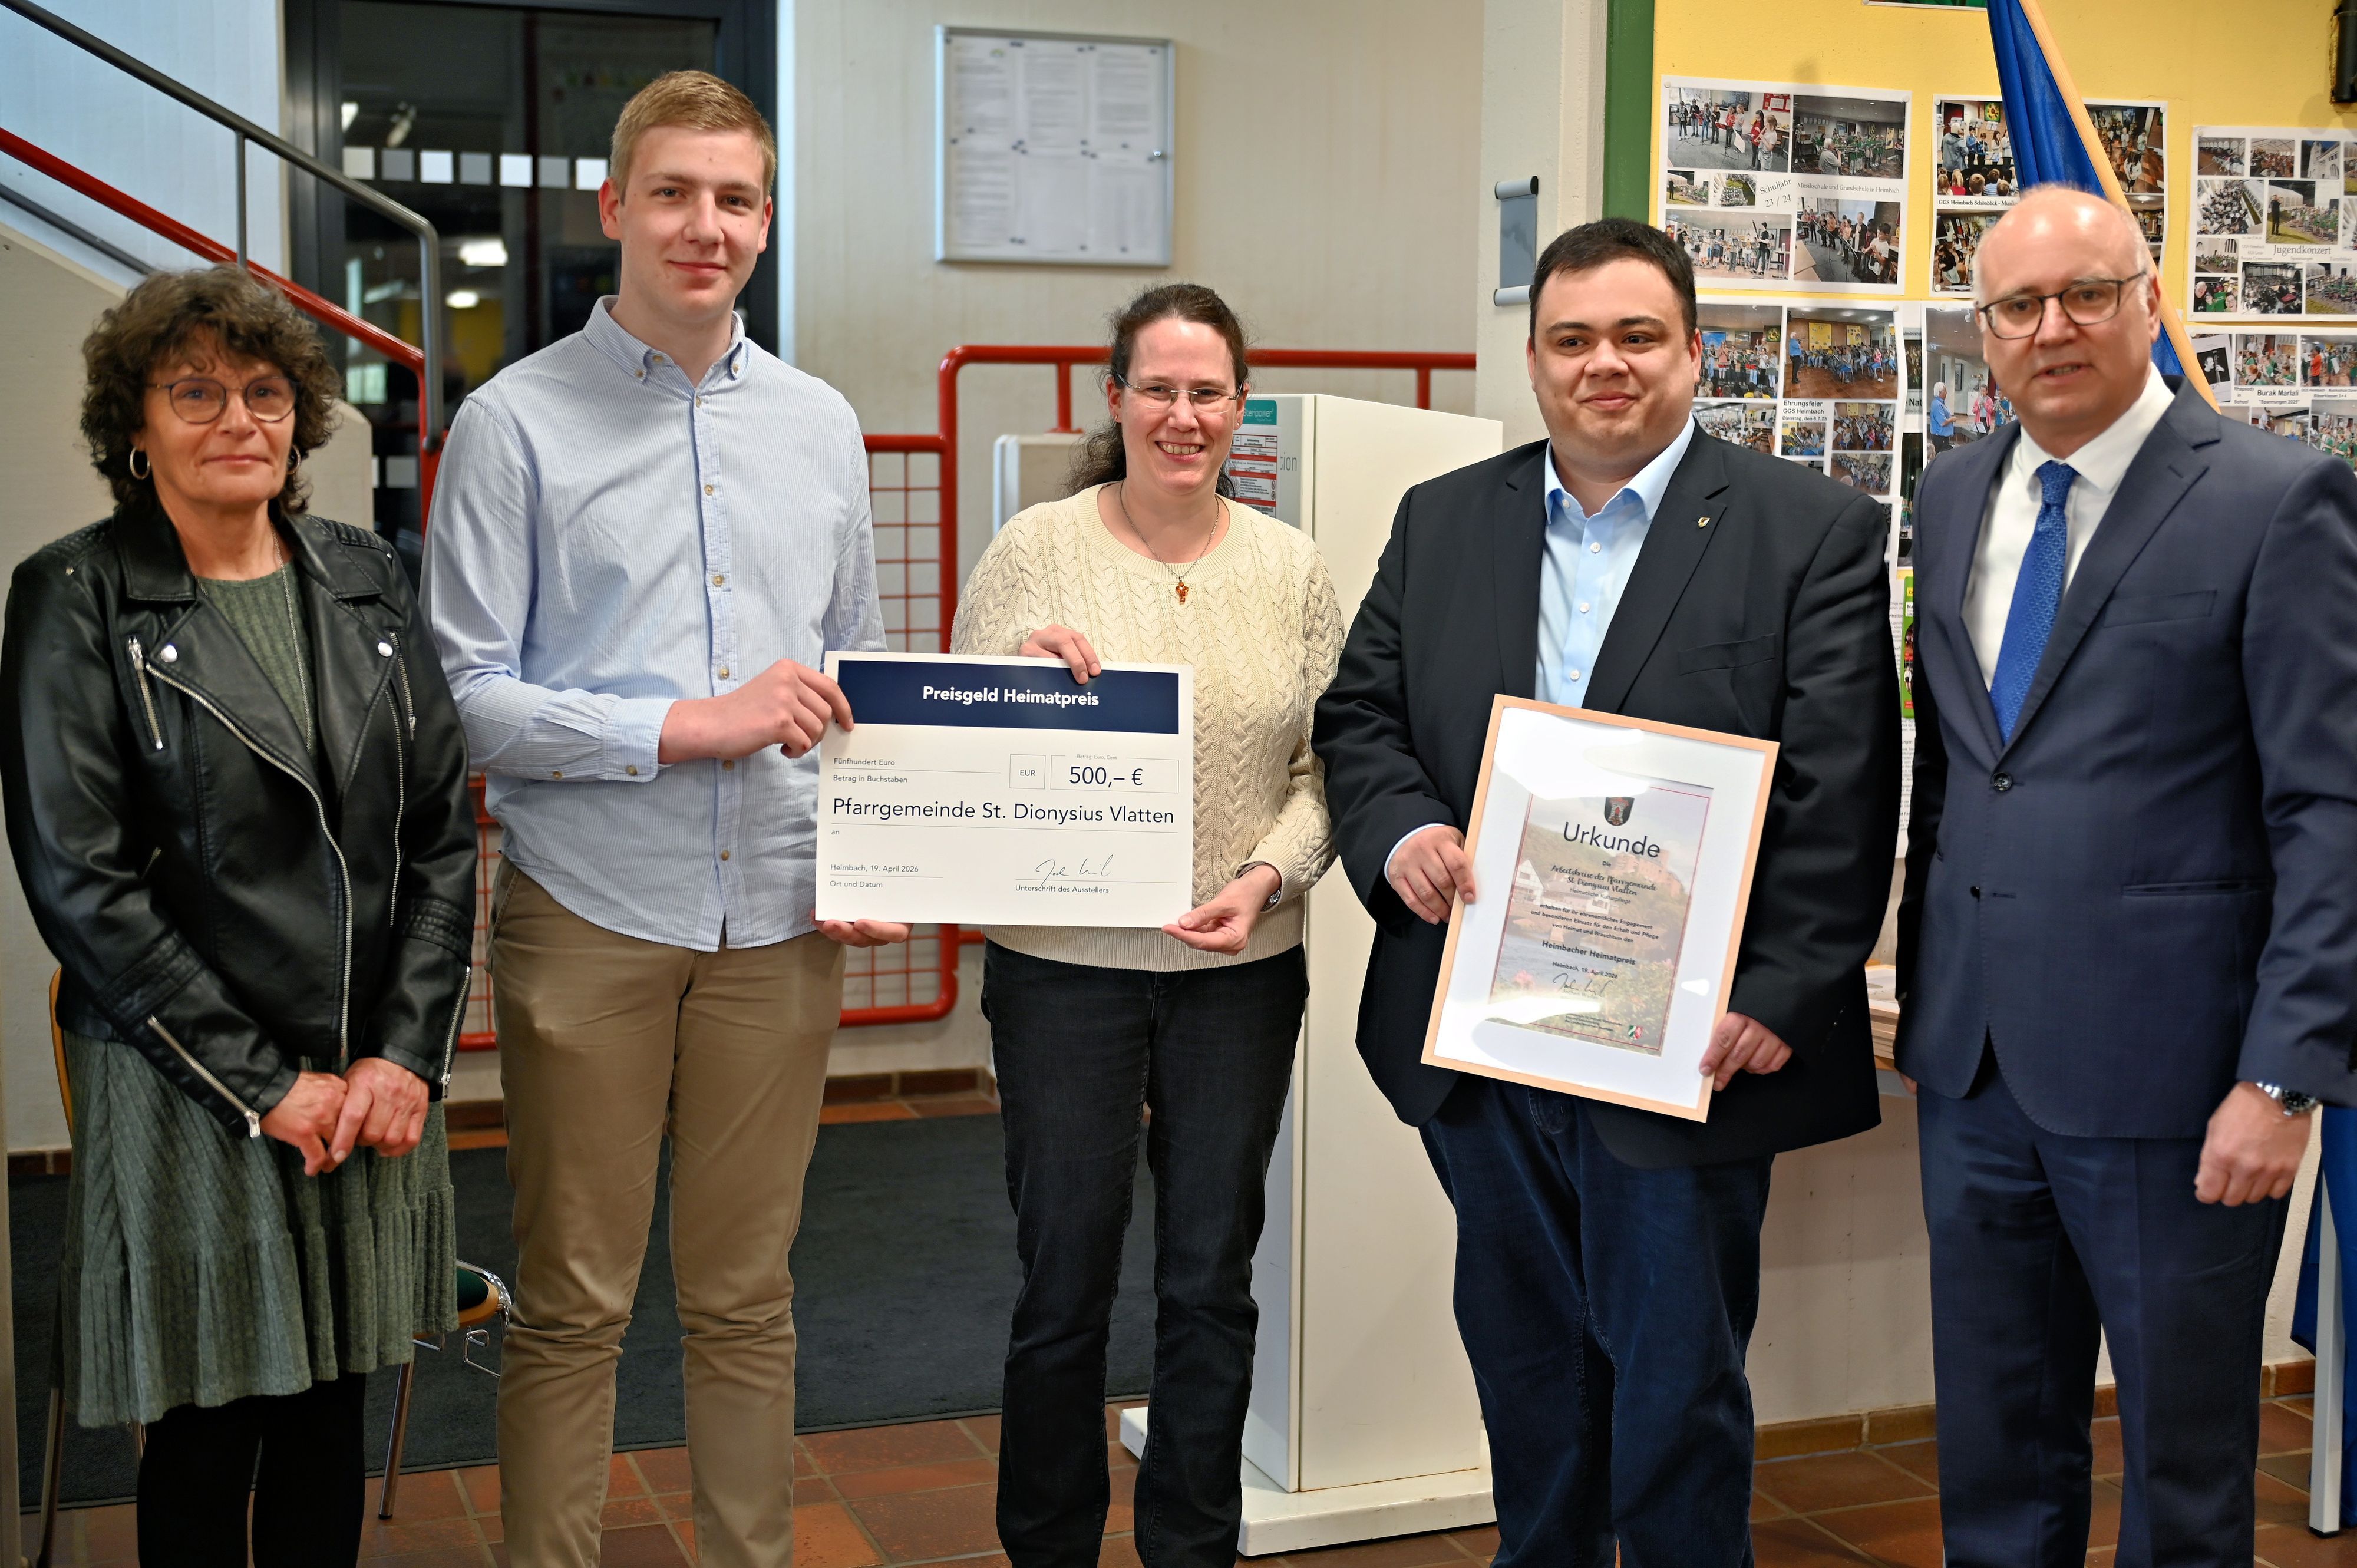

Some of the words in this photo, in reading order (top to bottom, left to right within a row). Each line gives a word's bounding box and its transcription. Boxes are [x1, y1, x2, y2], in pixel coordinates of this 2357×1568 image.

[1760, 178, 1792, 195] Schuljahr
[1783, 194, 1792, 203] 24
[2273, 245, 2331, 257] Jugendkonzert
[923, 685, 999, 705] Preisgeld
[1003, 688, 1100, 708] Heimatpreis
[833, 774, 857, 783] Betrag
[1131, 768, 1143, 786] €
[833, 798, 976, 820] Pfarrgemeinde
[982, 801, 1006, 818] St.
[1014, 803, 1104, 825] Dionysius
[1110, 806, 1174, 823] Vlatten
[1563, 821, 1661, 858] Urkunde
[830, 864, 868, 872] Heimbach,
[882, 865, 899, 874] April
[1577, 878, 1610, 892] Dionysius
[1612, 884, 1638, 896] Vlatten
[1606, 874, 1658, 892] Pfarrgemeinde
[1540, 903, 1562, 912] erhalten
[1579, 910, 1619, 923] ehrenamtliches
[1619, 918, 1653, 930] Engagement
[1541, 912, 1573, 922] besonderen
[1573, 918, 1593, 926] Einsatz
[1613, 926, 1629, 934] Erhalt
[1642, 931, 1659, 940] Pflege
[1563, 924, 1582, 933] Heimat
[1594, 930, 1623, 941] Brauchtum
[1541, 940, 1588, 955] Heimbacher
[1589, 949, 1636, 965] Heimatpreis
[1590, 968, 1604, 976] April
